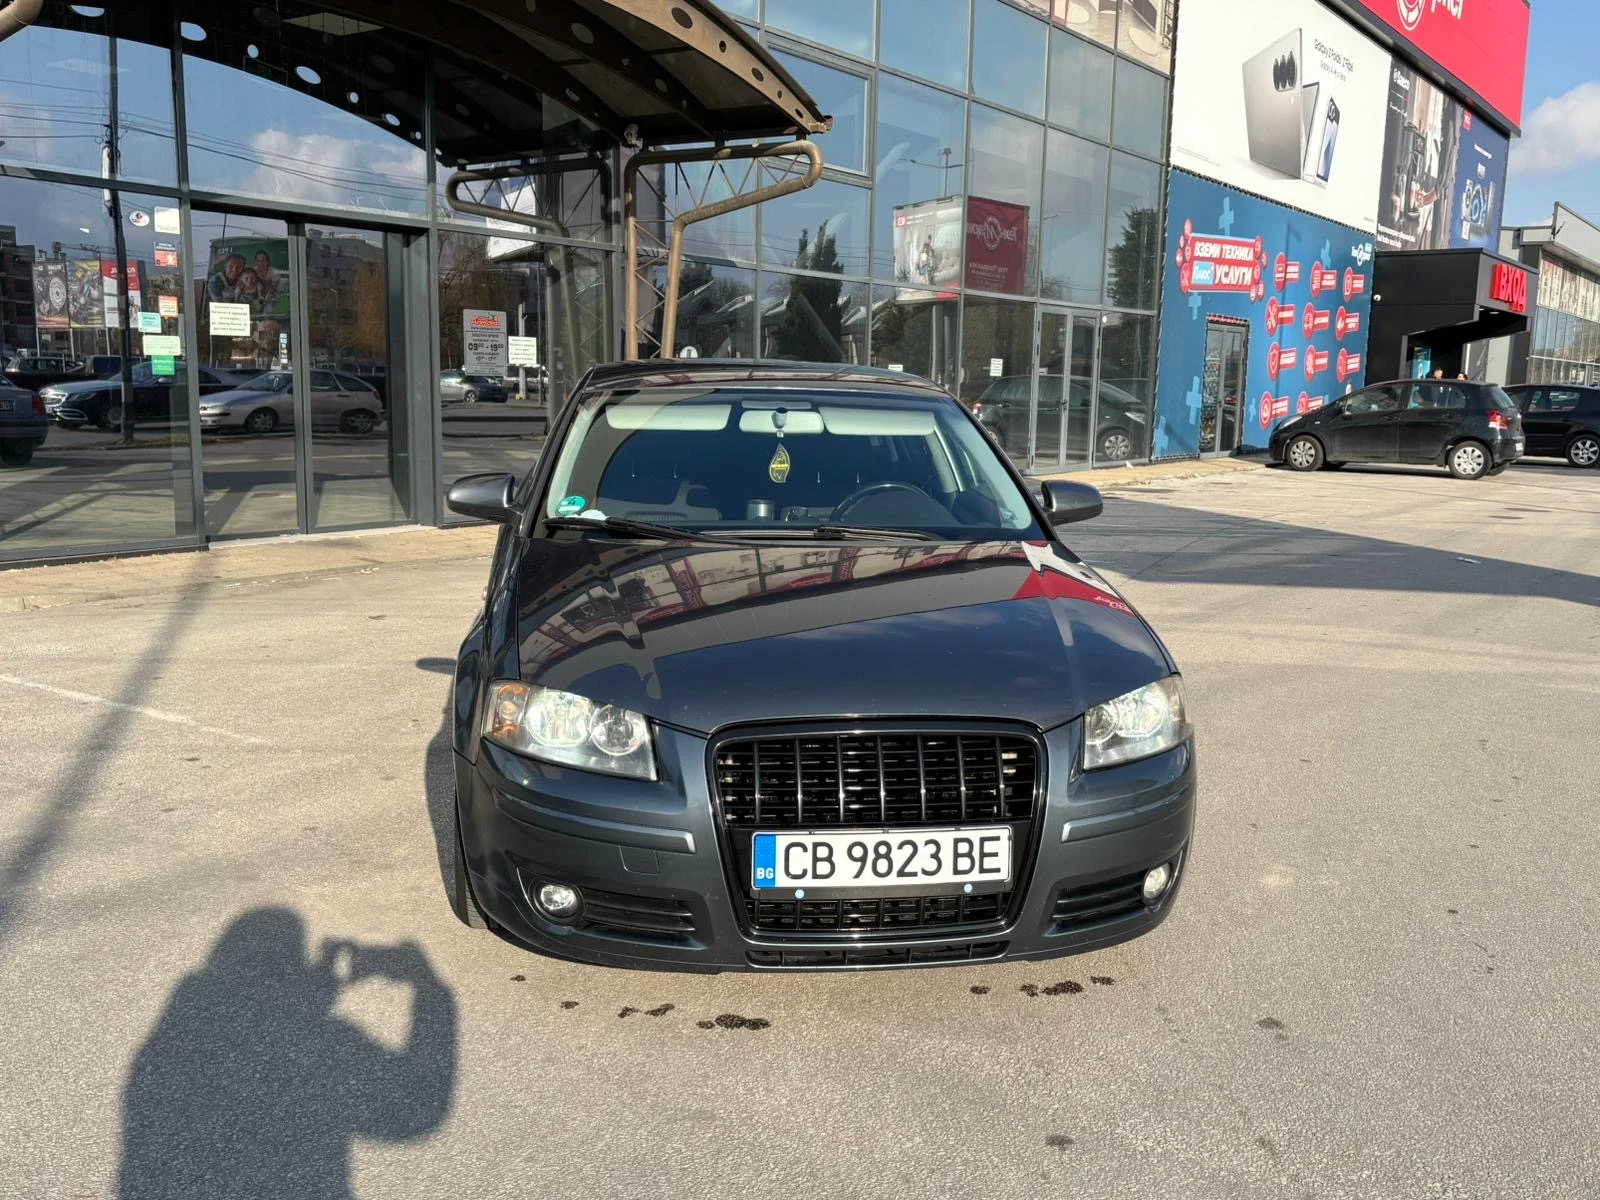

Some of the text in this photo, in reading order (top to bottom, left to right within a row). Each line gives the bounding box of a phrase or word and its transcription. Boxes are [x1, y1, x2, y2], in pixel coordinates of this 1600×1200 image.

[1194, 241, 1254, 261] ВЗЕМИ ТЕХНИКА
[1215, 264, 1252, 286] УСЛУГИ
[1494, 263, 1527, 312] ВХОД
[784, 835, 1001, 880] CB 9823 BE
[756, 868, 774, 879] BG
